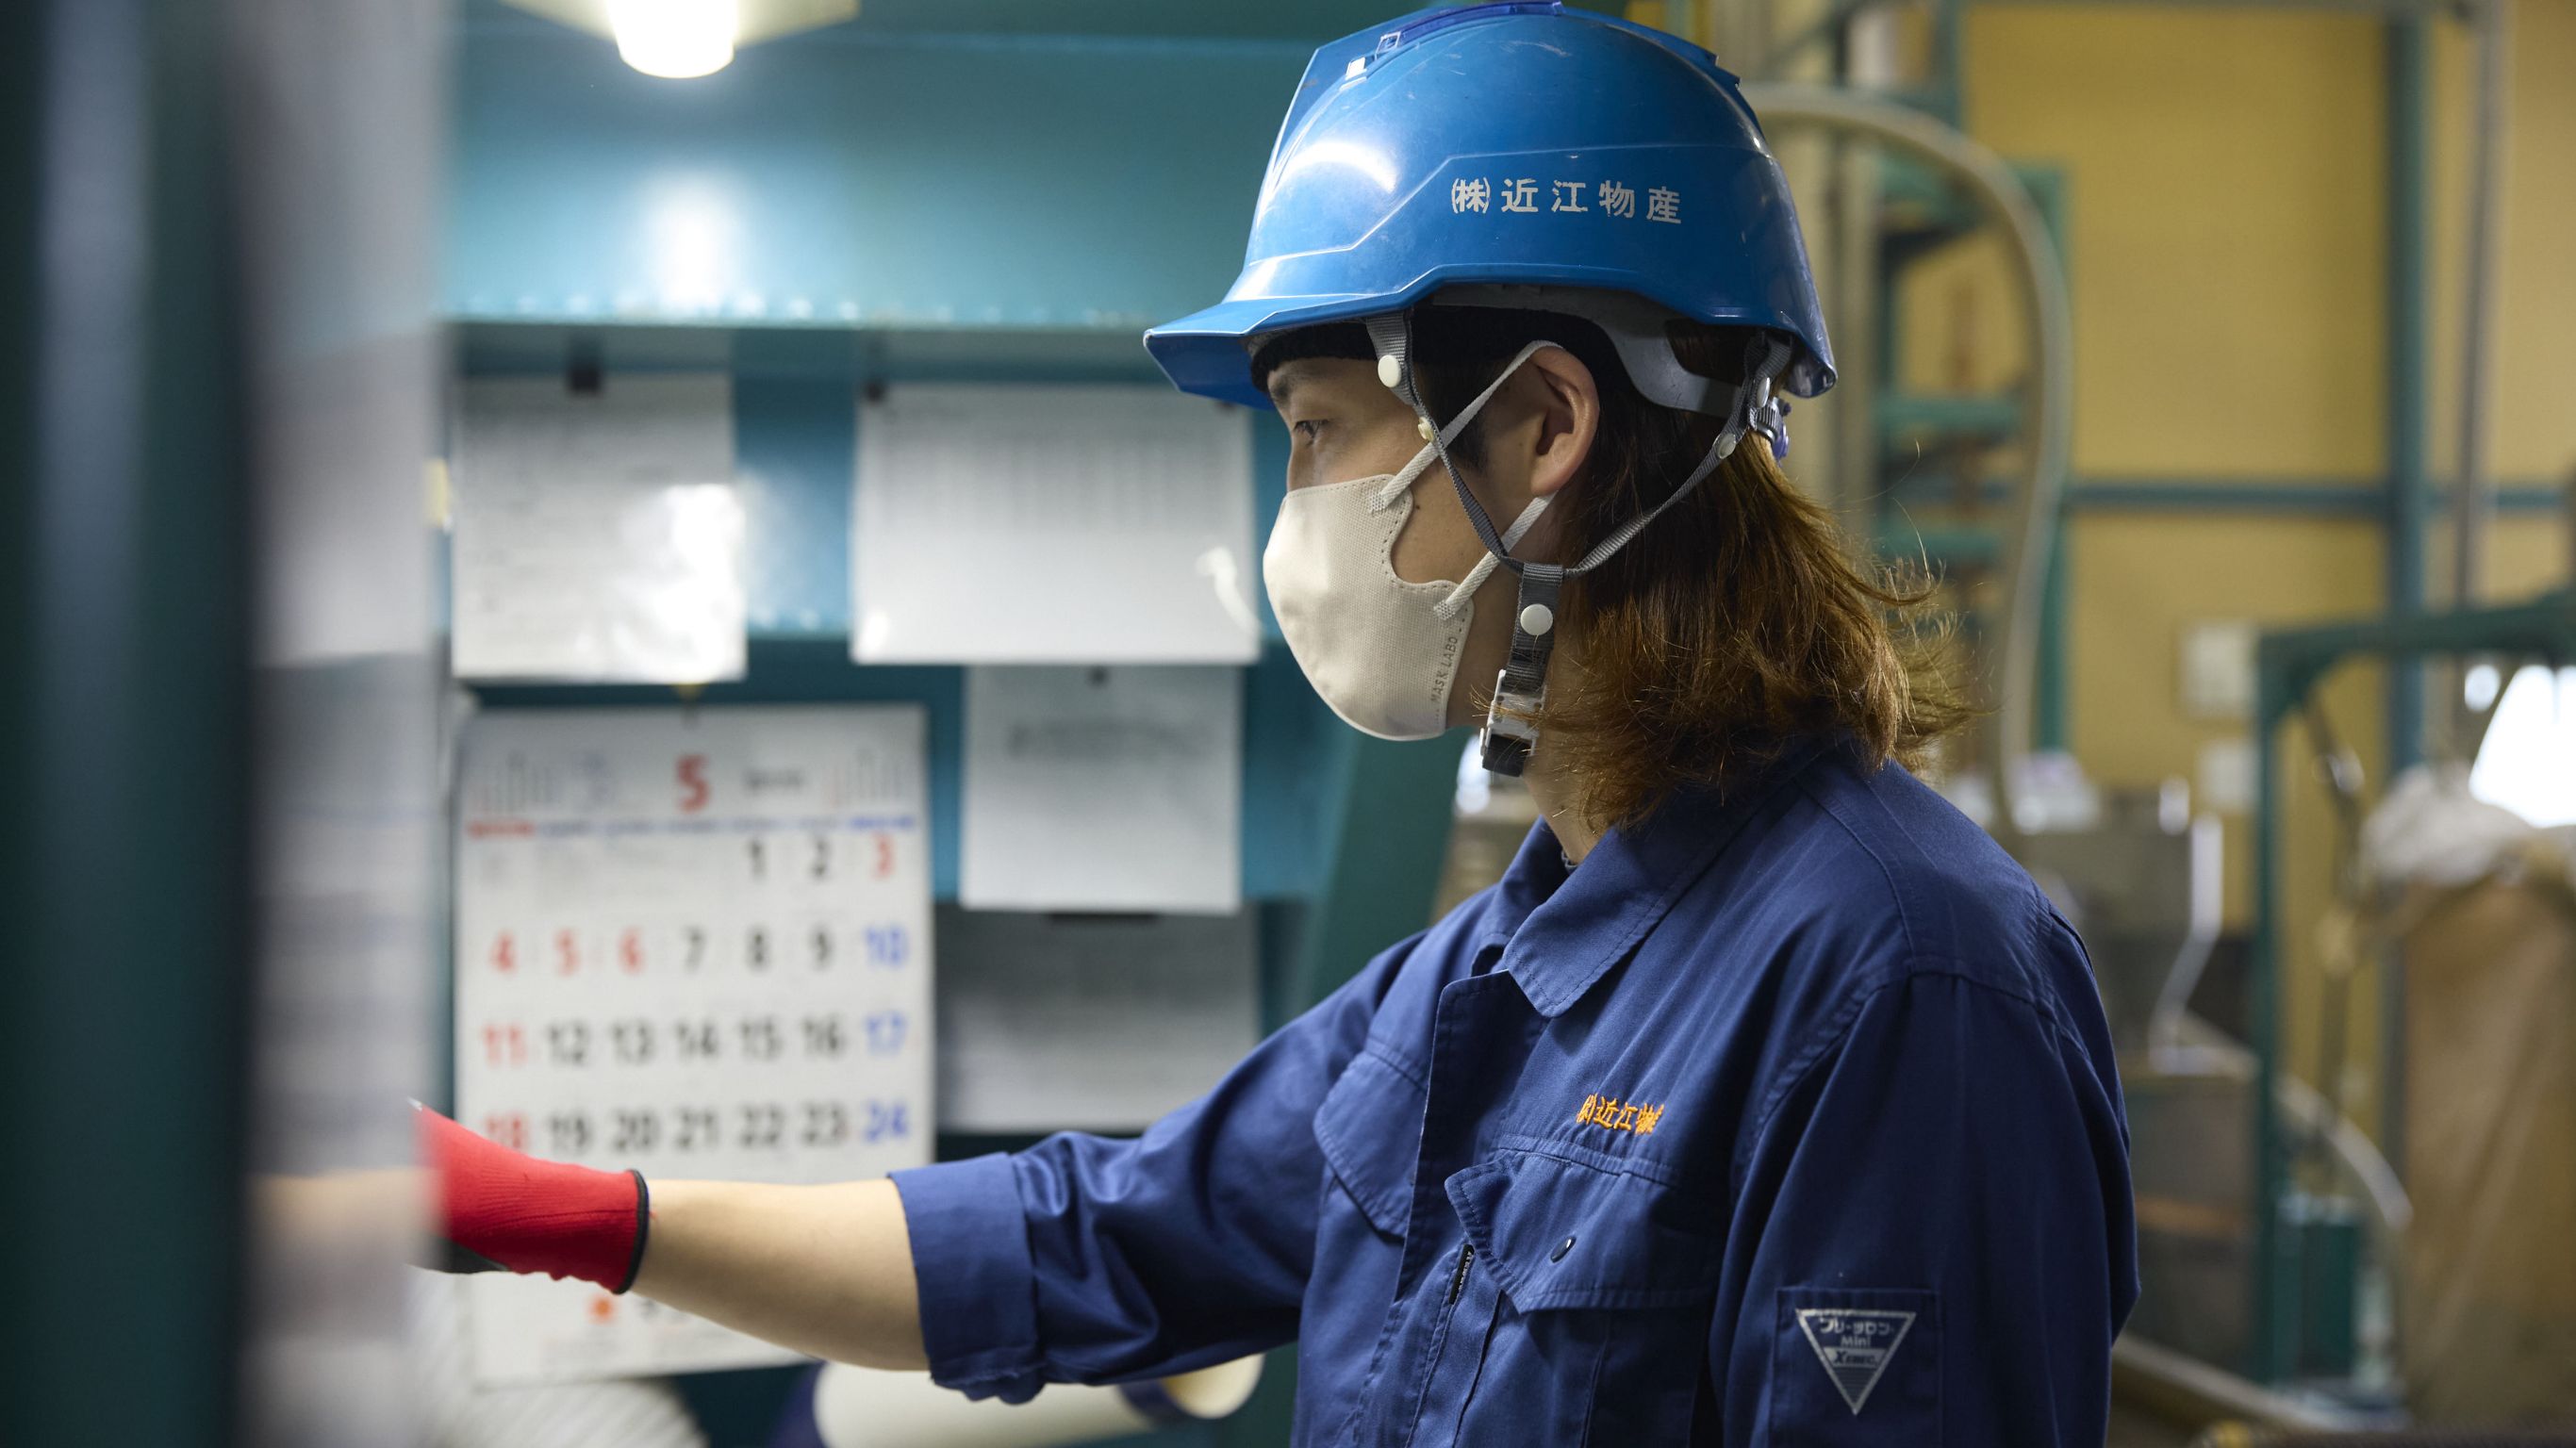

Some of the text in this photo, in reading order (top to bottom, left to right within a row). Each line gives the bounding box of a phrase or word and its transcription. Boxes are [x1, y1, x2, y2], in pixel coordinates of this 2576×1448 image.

[1430, 636, 1459, 703] MASK LABO
[677, 755, 708, 813] 5
[749, 833, 896, 880] 1 2 3
[491, 924, 908, 975] 4 5 6 7 8 9 10
[484, 1012, 908, 1067] 11 12 13 14 15 16 17
[485, 1100, 910, 1153] 18 19 20 21 22 23 24
